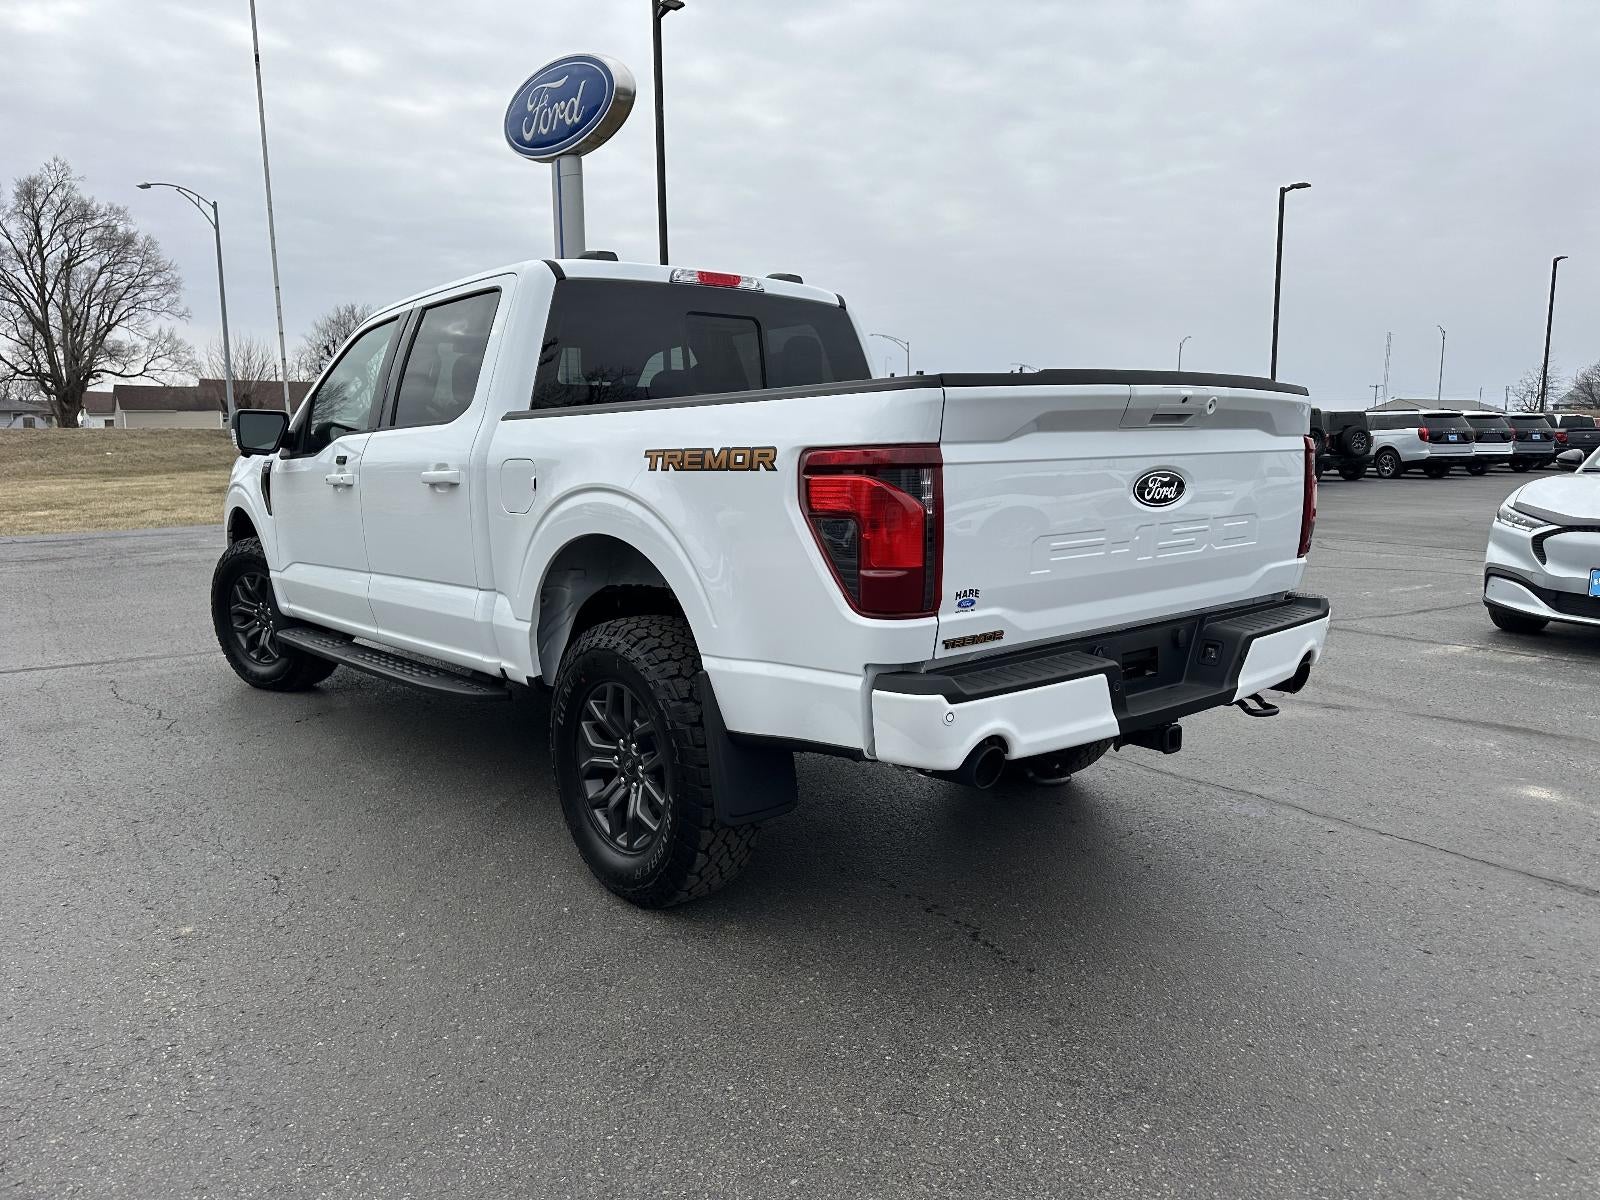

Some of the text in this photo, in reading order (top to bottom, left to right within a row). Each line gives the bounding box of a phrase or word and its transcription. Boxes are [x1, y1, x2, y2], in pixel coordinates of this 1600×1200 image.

[522, 75, 586, 142] Ford
[644, 446, 777, 471] TREMOR
[1144, 475, 1178, 500] Ford
[1030, 513, 1258, 574] F-150
[955, 588, 980, 601] HARE
[942, 629, 1005, 650] TREMOR
